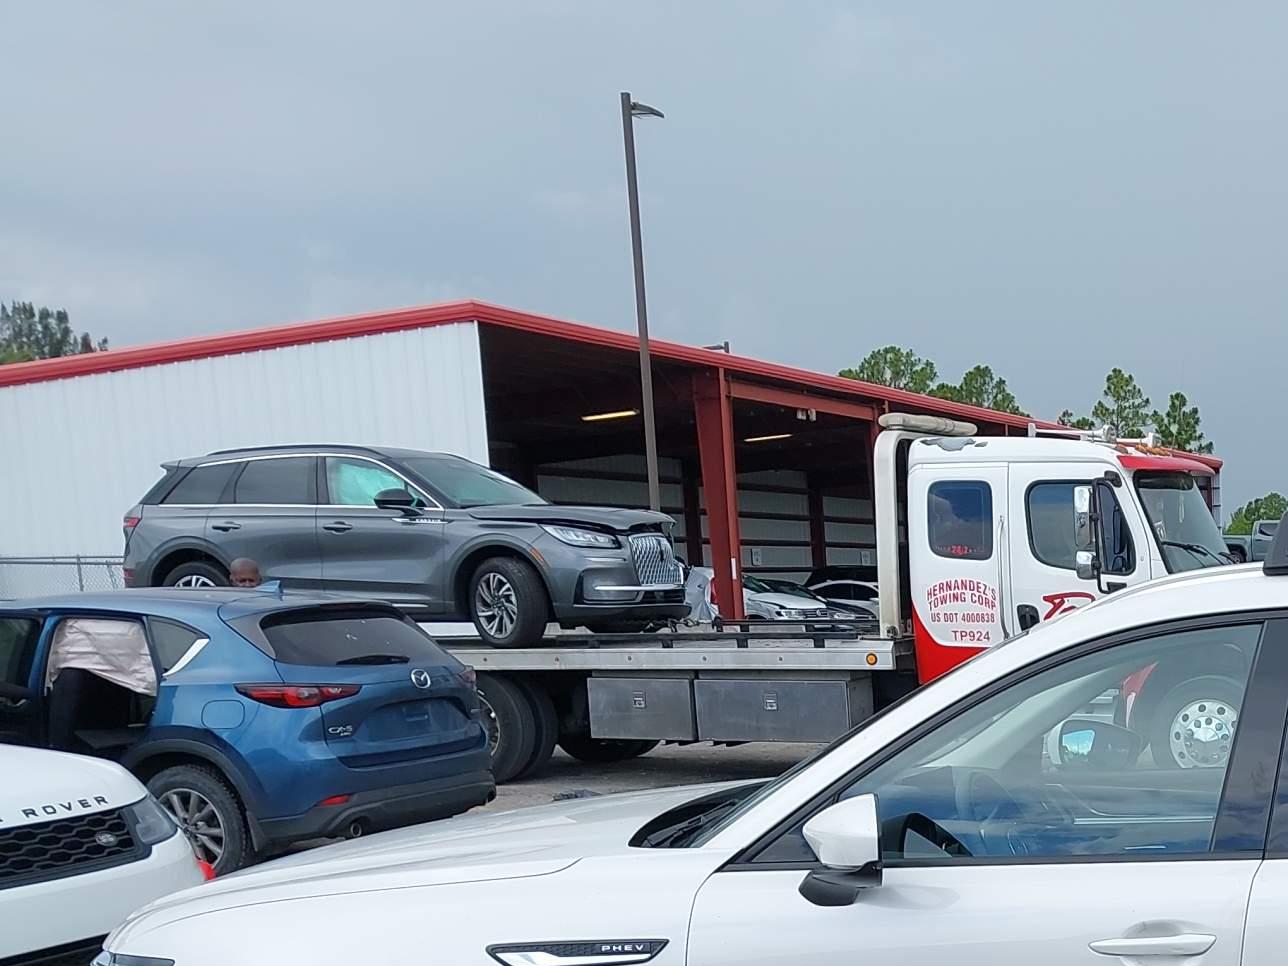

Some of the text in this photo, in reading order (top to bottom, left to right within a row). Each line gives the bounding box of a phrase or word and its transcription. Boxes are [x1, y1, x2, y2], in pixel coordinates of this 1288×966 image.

[927, 579, 996, 600] HERNANDEZ'S
[928, 592, 996, 611] TOWING CORP
[931, 613, 940, 622] US
[944, 613, 958, 623] DOT
[952, 631, 991, 641] TP924
[21, 796, 108, 818] ROVER
[601, 944, 644, 952] PHEV
